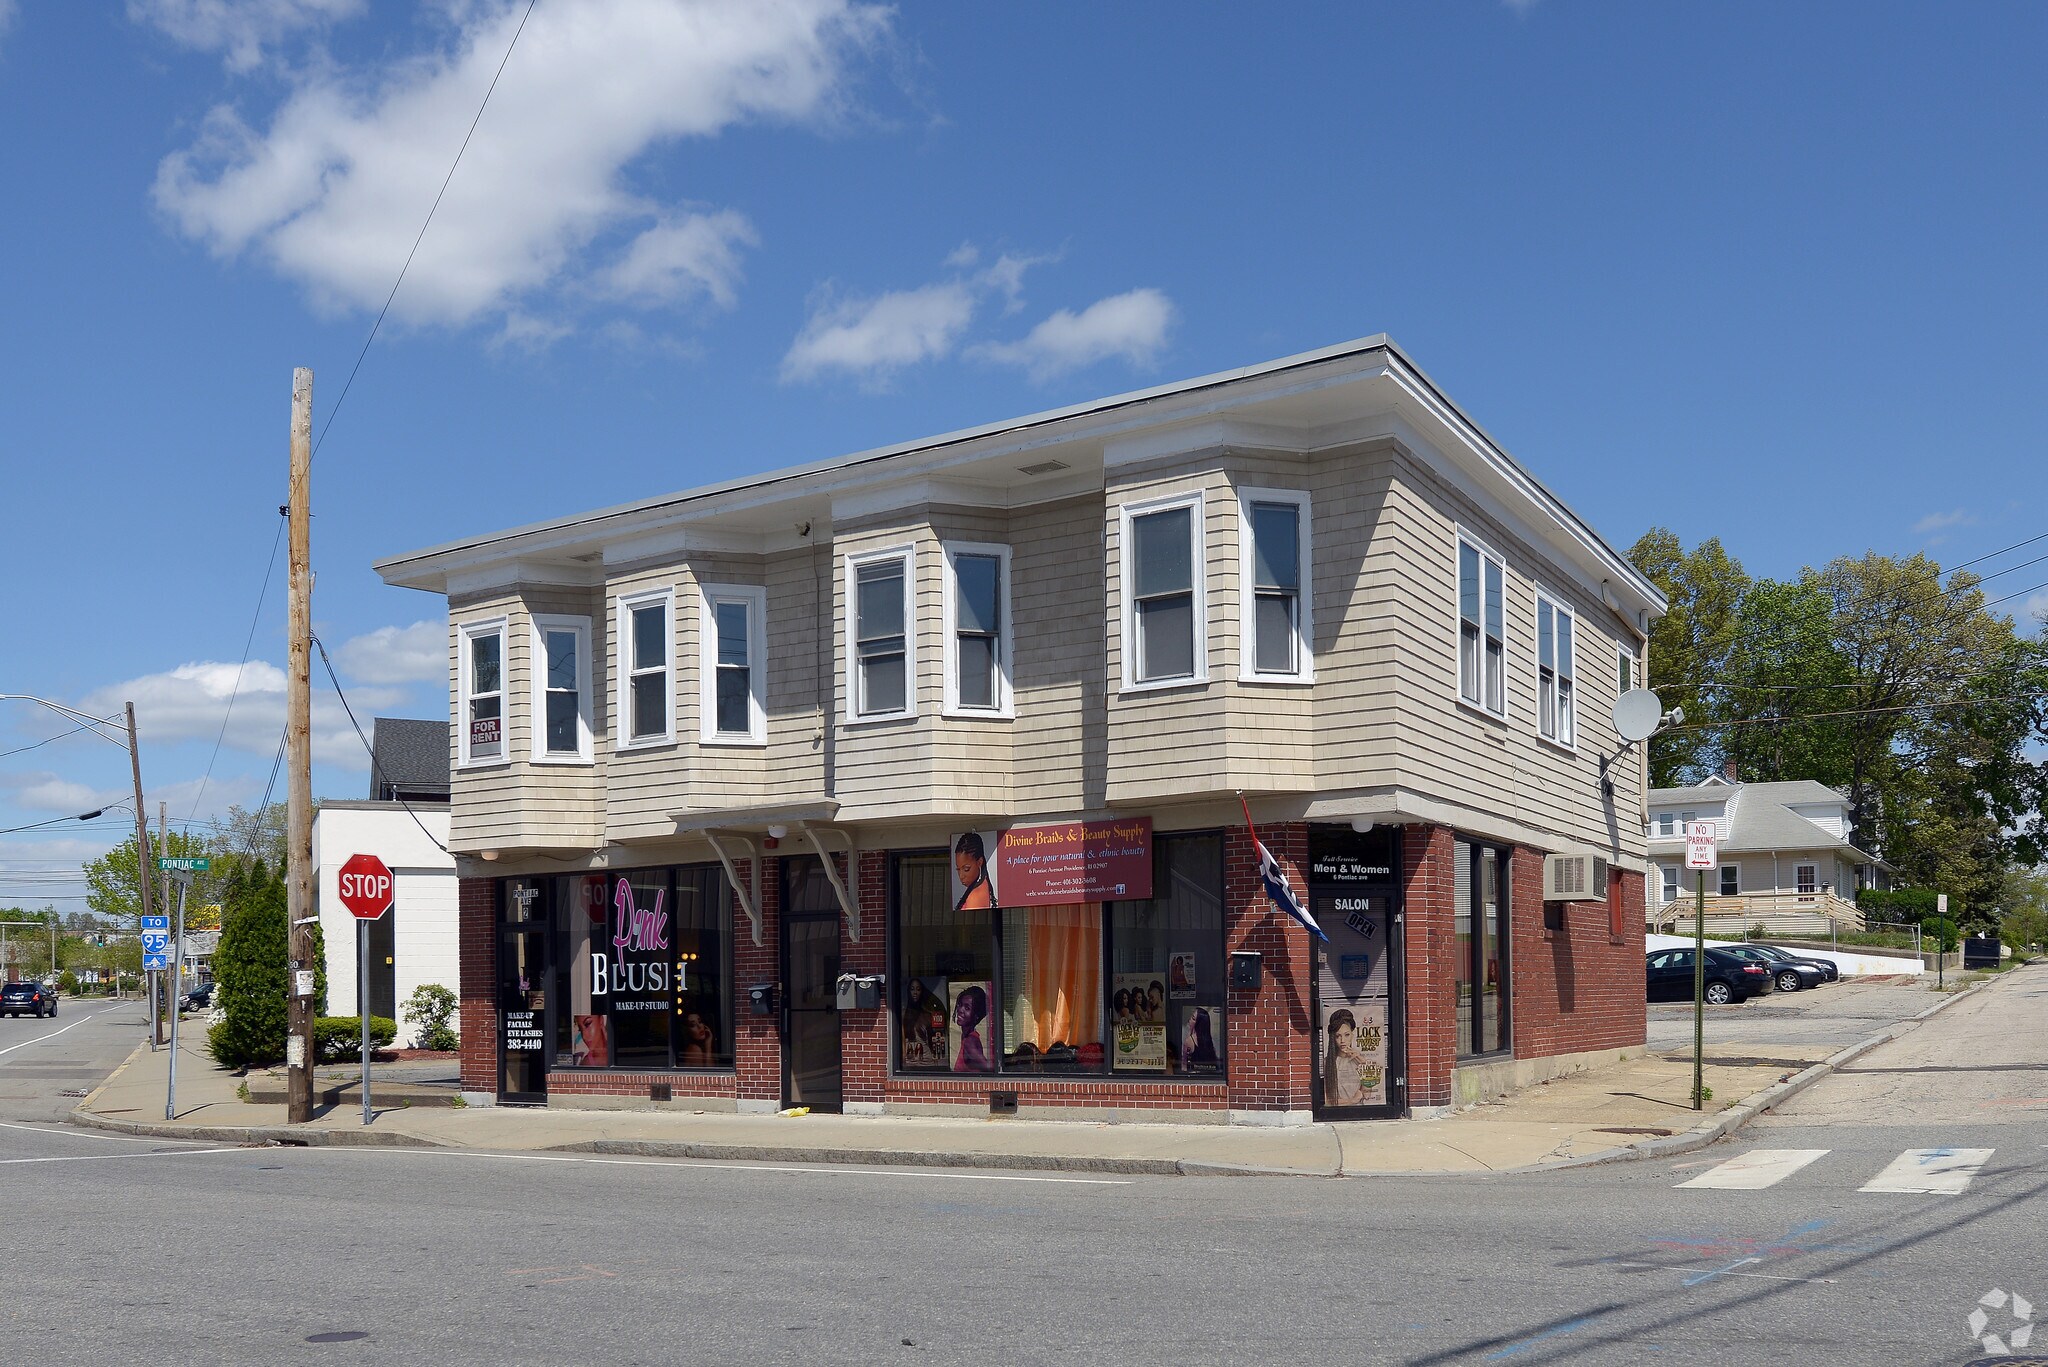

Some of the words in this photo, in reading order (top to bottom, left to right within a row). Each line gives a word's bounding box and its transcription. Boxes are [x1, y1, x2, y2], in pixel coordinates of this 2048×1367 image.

[474, 721, 496, 733] FOR
[471, 731, 500, 744] RENT
[1696, 826, 1706, 834] NO
[1005, 833, 1033, 849] Divine
[1035, 831, 1064, 846] Braids
[1066, 829, 1078, 842] &
[1081, 826, 1111, 847] Beauty
[1114, 824, 1145, 845] Supply
[1689, 836, 1714, 845] PARKING
[1007, 857, 1012, 865] A
[1012, 855, 1030, 869] place
[1029, 853, 1041, 866] for
[1043, 855, 1059, 865] your
[1060, 850, 1085, 861] natural
[1087, 850, 1096, 859] &
[1099, 848, 1119, 858] ethnic
[1121, 846, 1146, 857] beauty
[162, 860, 194, 869] PONTIAC
[1314, 864, 1336, 873] Men
[1339, 864, 1348, 873] &
[1351, 864, 1389, 874] Women
[342, 873, 390, 899] STOP
[513, 889, 538, 898] PONTIAC
[1335, 899, 1369, 910] SALON
[523, 907, 528, 919] 2
[148, 918, 162, 926] TO
[613, 878, 668, 977] Pink
[1348, 913, 1376, 939] OPEN
[144, 935, 165, 949] 95
[591, 953, 688, 996] BLUSH
[616, 1001, 644, 1011] MAKE-UP
[645, 1001, 669, 1010] STUDIO
[507, 1012, 534, 1020] MAKE-UP
[1357, 1027, 1380, 1038] LOCK
[507, 1039, 542, 1049] 383-4440
[1356, 1038, 1381, 1048] TWIST
